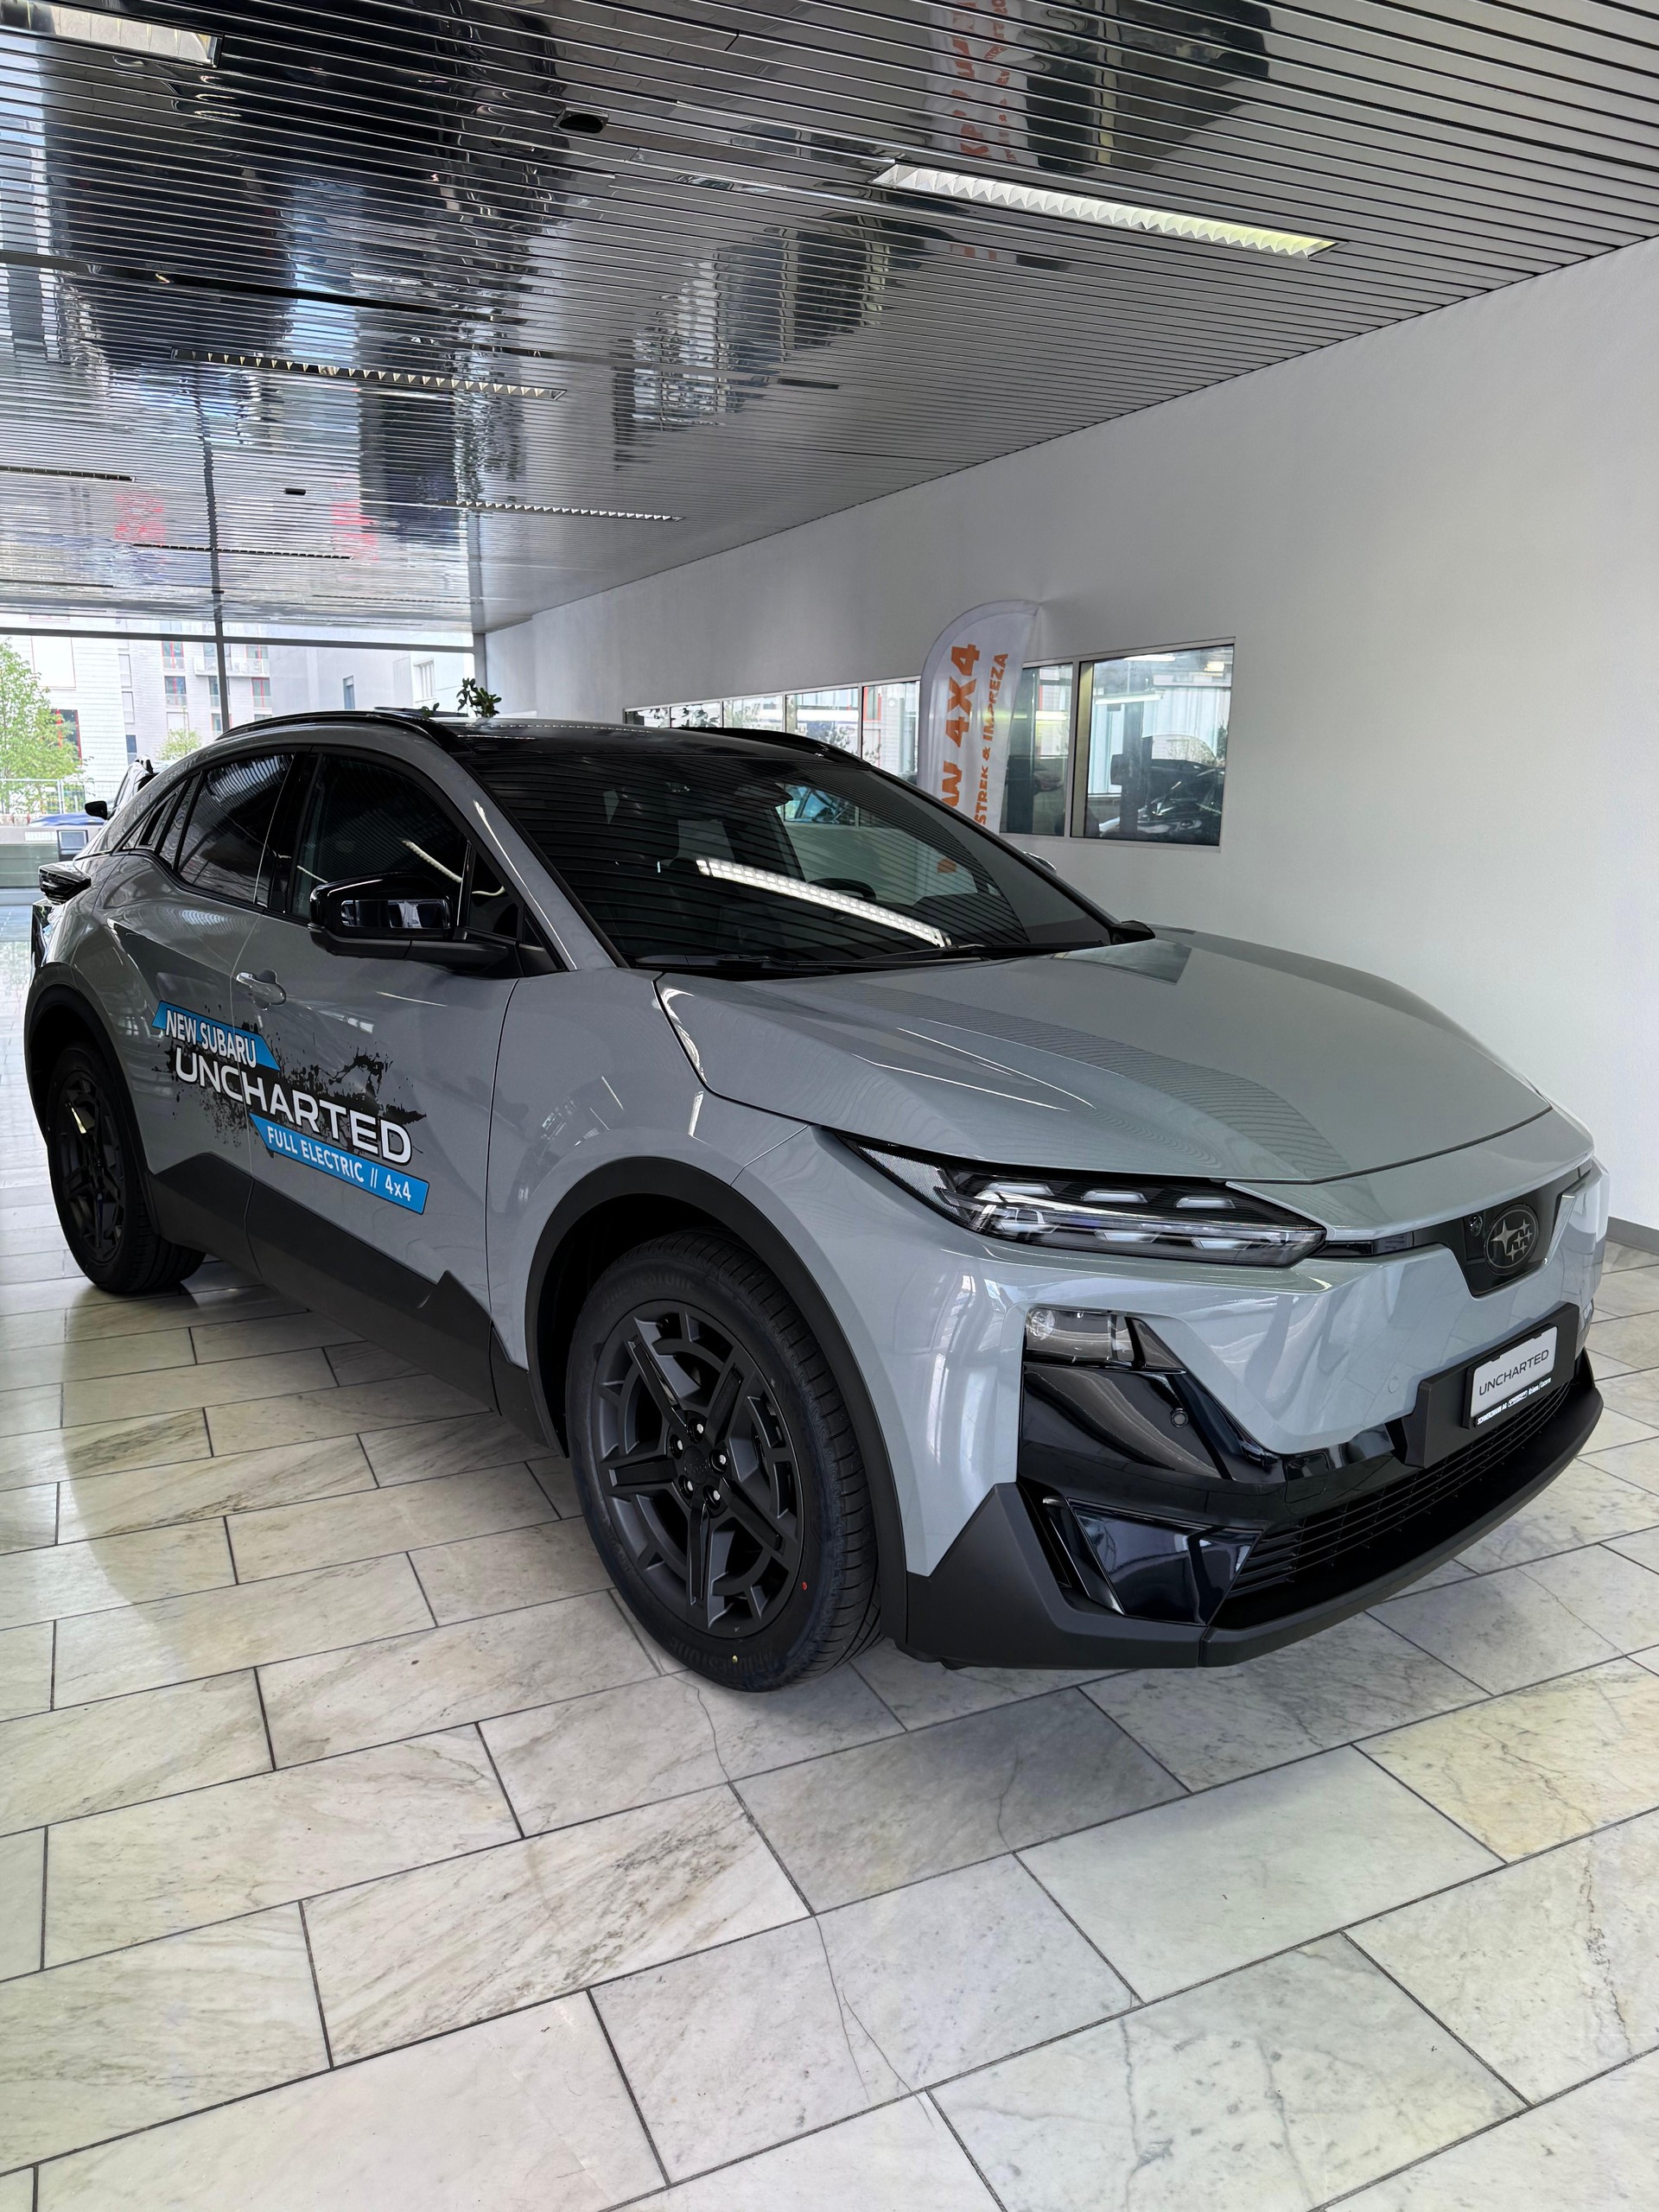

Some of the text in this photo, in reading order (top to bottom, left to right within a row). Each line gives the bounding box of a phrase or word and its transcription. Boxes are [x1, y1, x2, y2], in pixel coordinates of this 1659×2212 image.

[945, 644, 981, 748] 4X4
[982, 653, 1009, 741] IMPREZA
[982, 746, 991, 761] &
[165, 1009, 257, 1068] NEW SUBARU
[175, 1046, 413, 1166] UNCHARTED
[266, 1126, 412, 1201] FULL ELECTRIC 4x4
[1478, 1349, 1549, 1396] UNCHARTED
